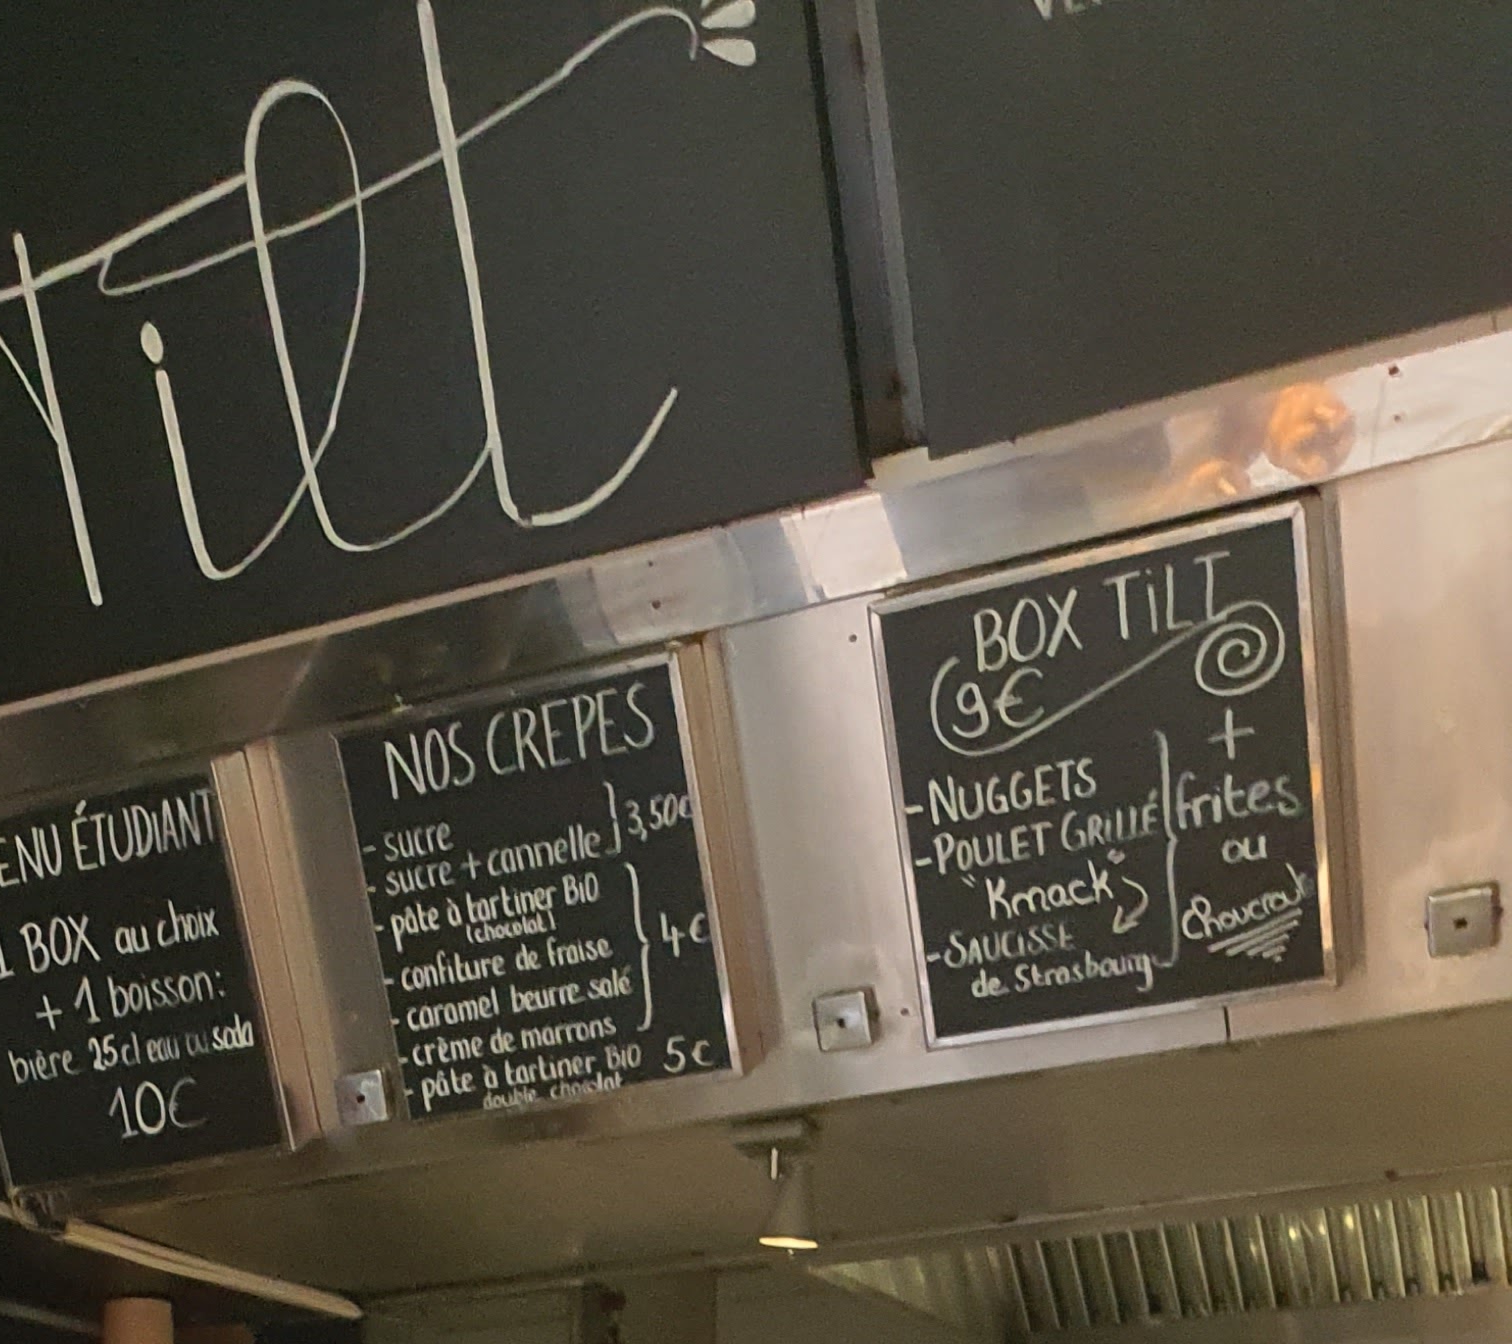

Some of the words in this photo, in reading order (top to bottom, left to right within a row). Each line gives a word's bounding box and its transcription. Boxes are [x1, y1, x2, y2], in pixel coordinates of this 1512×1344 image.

[972, 586, 1083, 673] BOX
[950, 666, 1045, 738] 9€
[383, 720, 476, 800] NOS
[486, 682, 655, 777] CREPES
[72, 788, 217, 871] ÉTUDIANT
[384, 820, 454, 861] sucre
[385, 860, 455, 897] sucre
[461, 850, 482, 881] +
[487, 823, 602, 877] cannelle
[1222, 835, 1267, 866] ou
[20, 914, 102, 974] BOX
[115, 926, 150, 955] au
[157, 900, 220, 949] choix
[390, 903, 440, 953] pâte
[446, 894, 464, 928] à
[466, 884, 557, 926] tartiner
[400, 950, 506, 993] confiture
[515, 942, 543, 973] de
[546, 934, 614, 969] fraise
[971, 968, 1010, 998] de
[35, 995, 63, 1031] +
[74, 978, 101, 1024] 1
[406, 987, 500, 1032] caramel
[510, 979, 581, 1013] beurre
[587, 964, 633, 999] salé
[7, 1048, 80, 1085] bière
[147, 1035, 180, 1062] eau
[211, 1012, 255, 1051] soda
[411, 1030, 484, 1067] crème
[490, 1024, 517, 1055] de
[521, 1014, 617, 1049] marrons
[108, 1076, 209, 1139] 10€
[420, 1065, 474, 1111] pâte
[483, 1063, 499, 1090] à
[503, 1050, 597, 1087] tartiner
[483, 1085, 537, 1110] double
